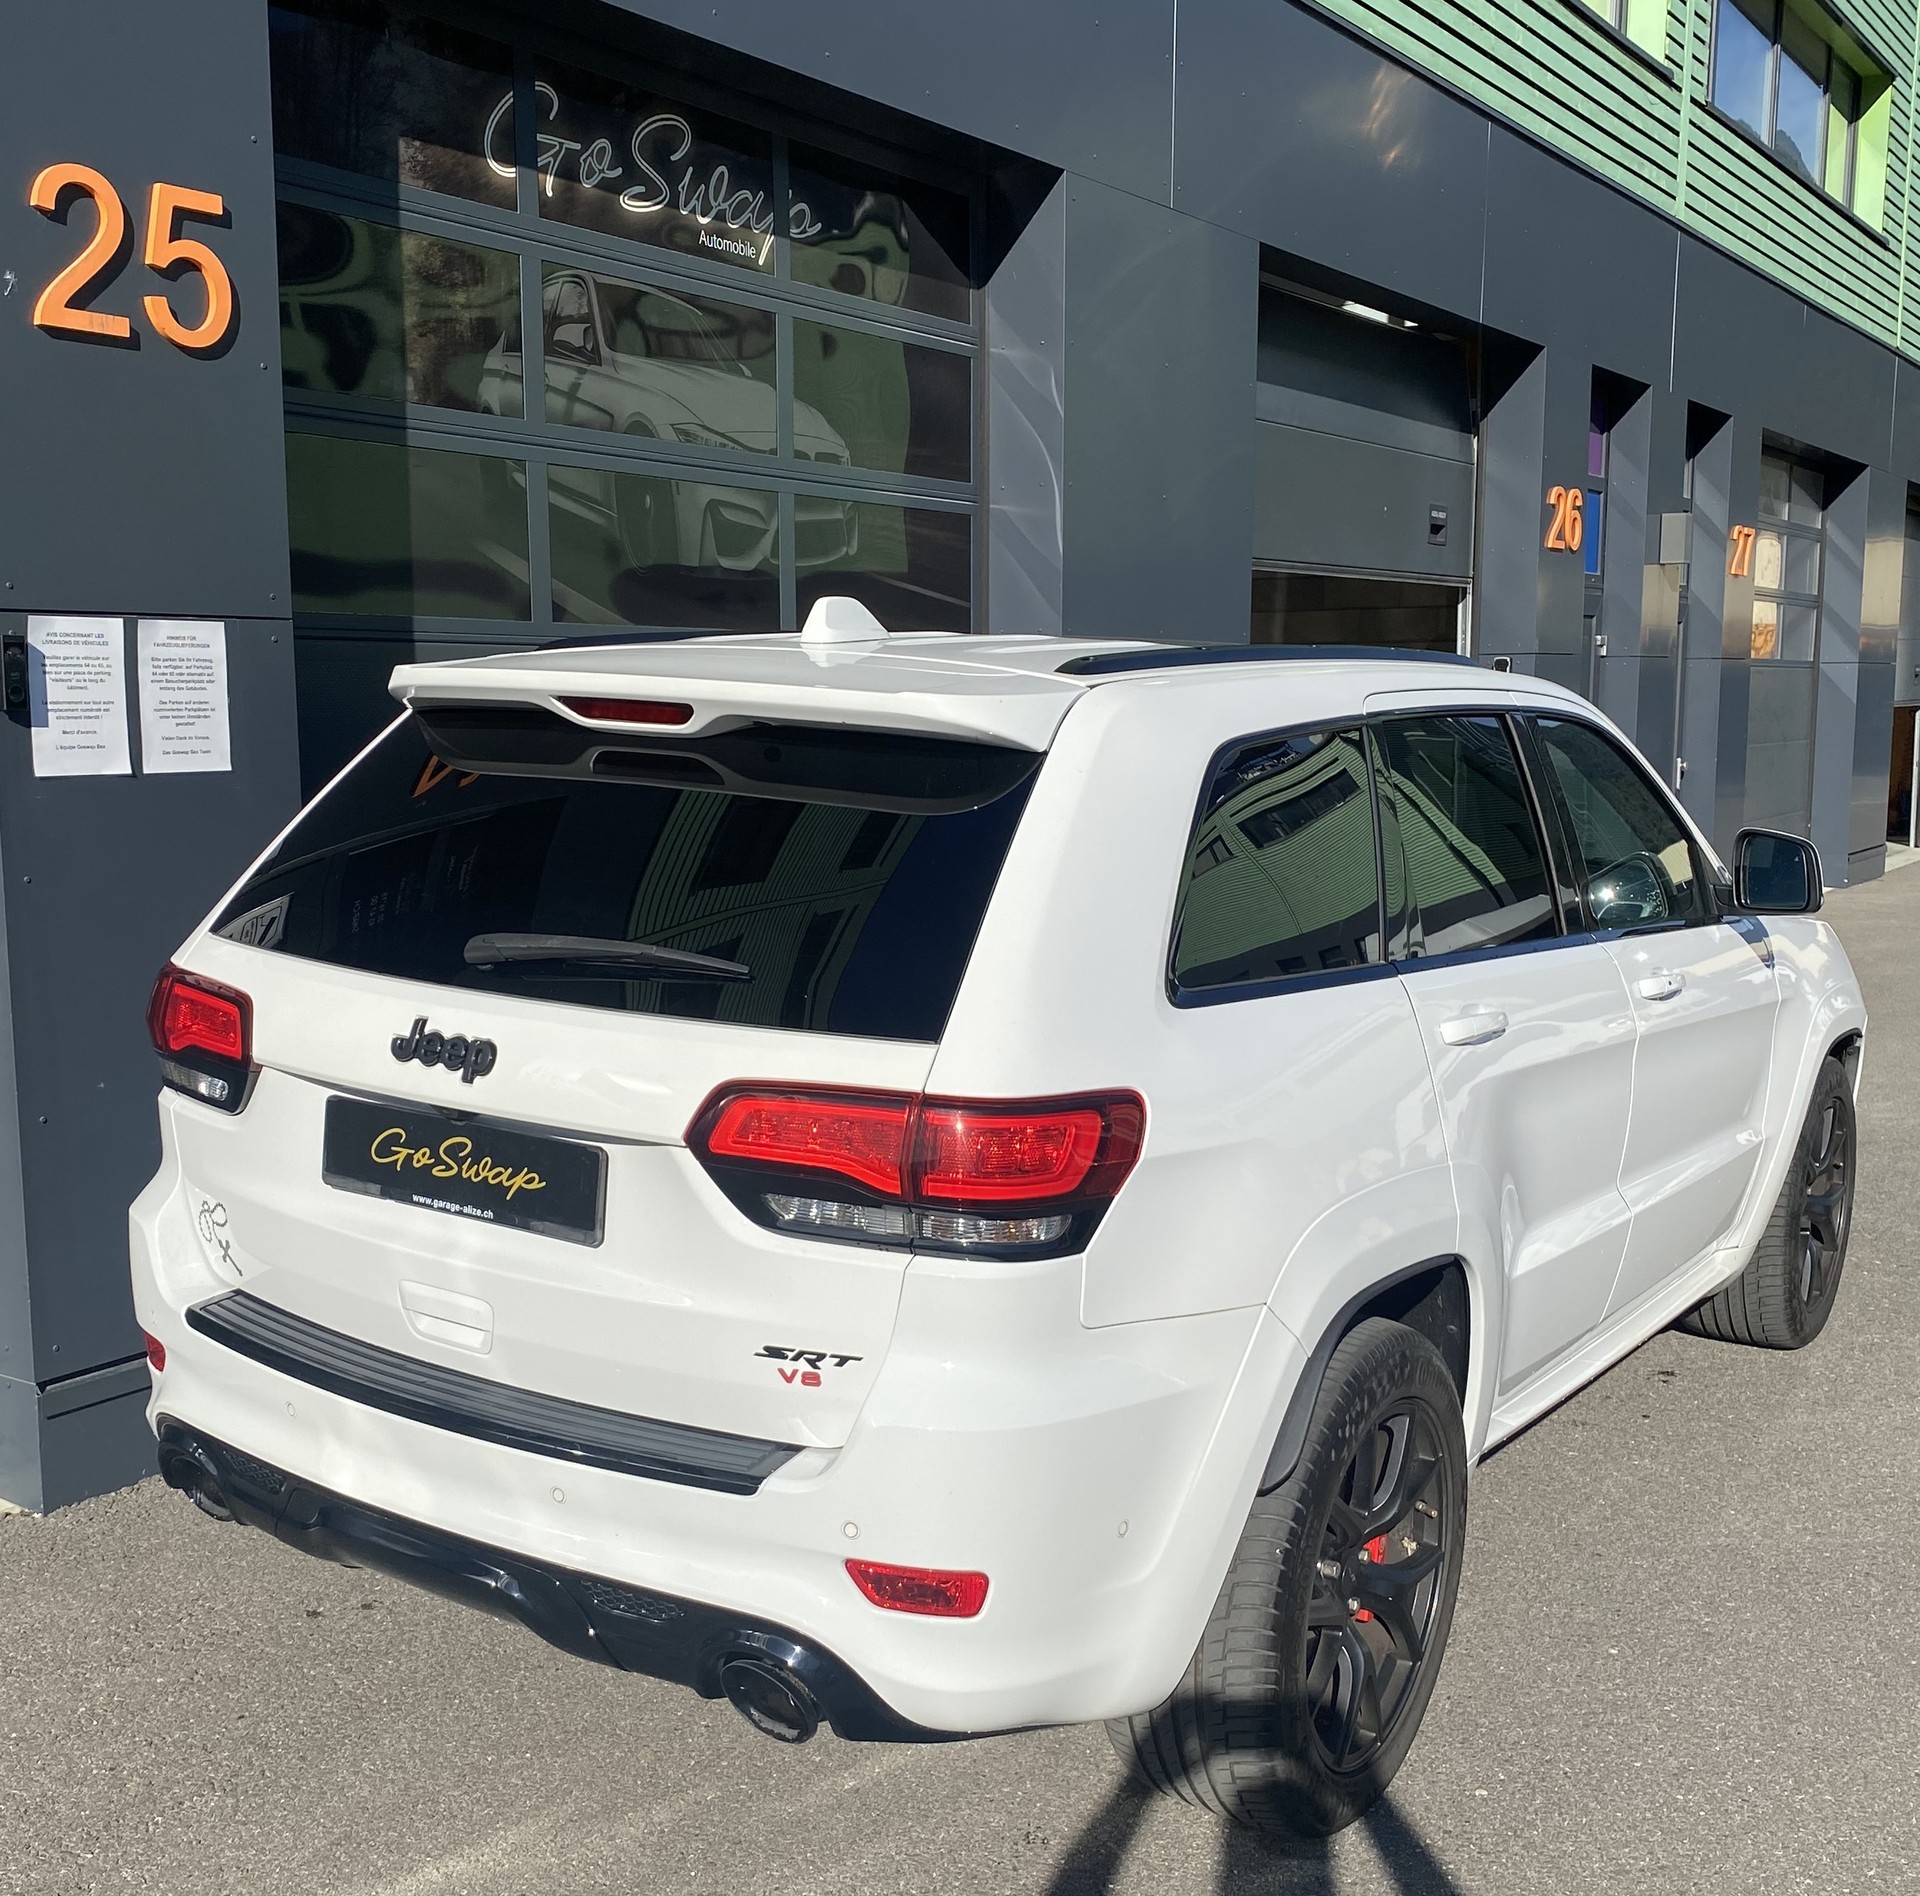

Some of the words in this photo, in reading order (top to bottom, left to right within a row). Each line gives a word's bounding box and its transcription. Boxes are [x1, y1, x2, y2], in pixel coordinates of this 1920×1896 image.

[29, 162, 233, 349] 25
[698, 229, 757, 259] Automobile
[1544, 485, 1583, 551] 26
[1730, 524, 1756, 577] 27
[390, 1014, 498, 1085] Jeep
[371, 1127, 547, 1200] GoSwap
[412, 1192, 494, 1220] www.garage-alize.ch
[753, 1345, 864, 1370] SRT
[777, 1368, 822, 1388] V8
